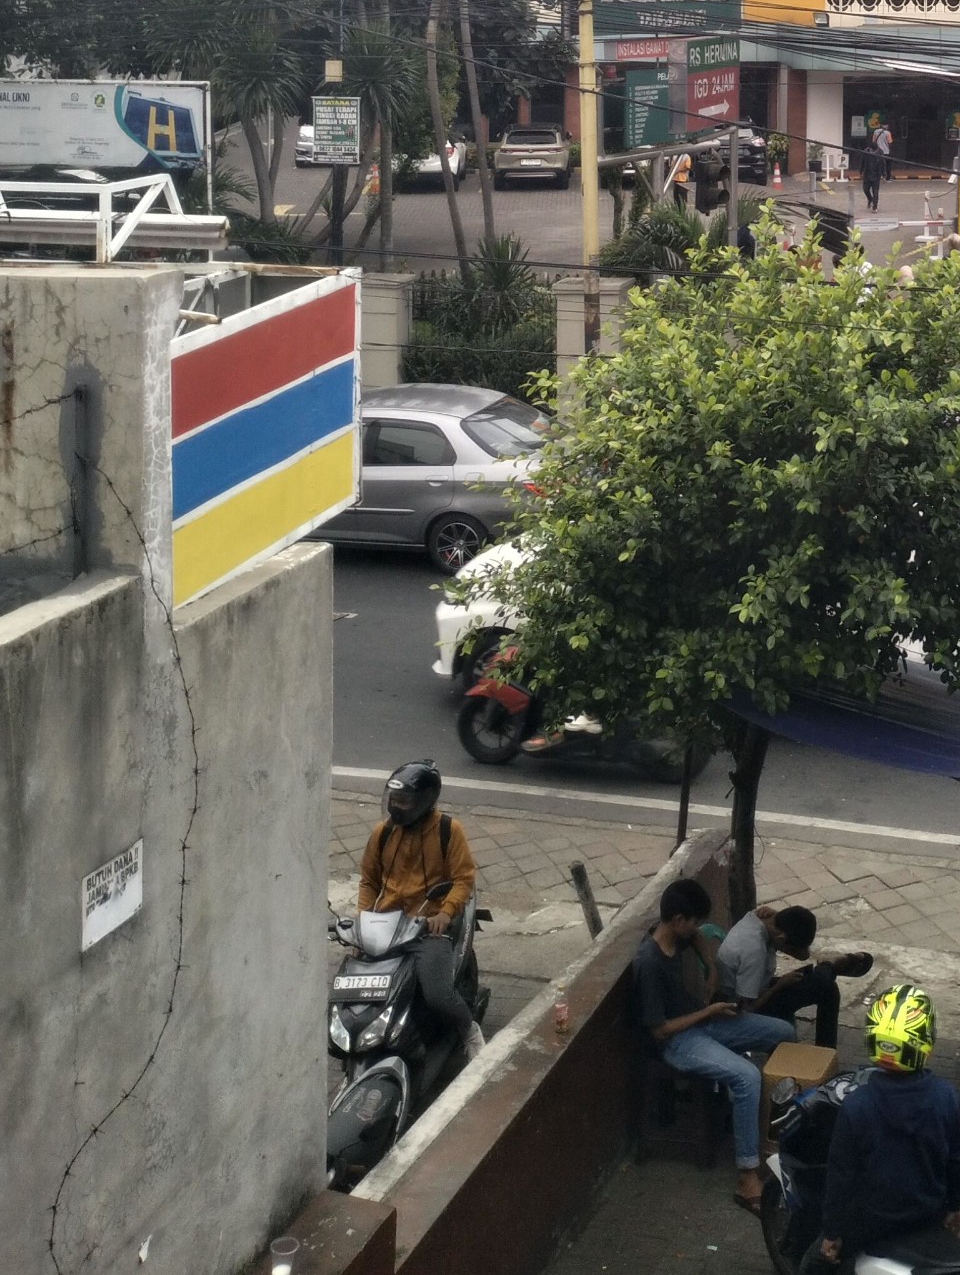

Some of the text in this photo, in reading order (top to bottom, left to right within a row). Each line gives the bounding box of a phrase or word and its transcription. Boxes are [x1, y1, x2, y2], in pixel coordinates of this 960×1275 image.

[617, 42, 645, 57] INSTALASI
[646, 41, 666, 55] GAWAT
[689, 42, 738, 67] RS HERMINA
[86, 863, 113, 893] BUTUH
[113, 851, 133, 874] DANA
[334, 977, 340, 988] B
[345, 977, 368, 988] 3173
